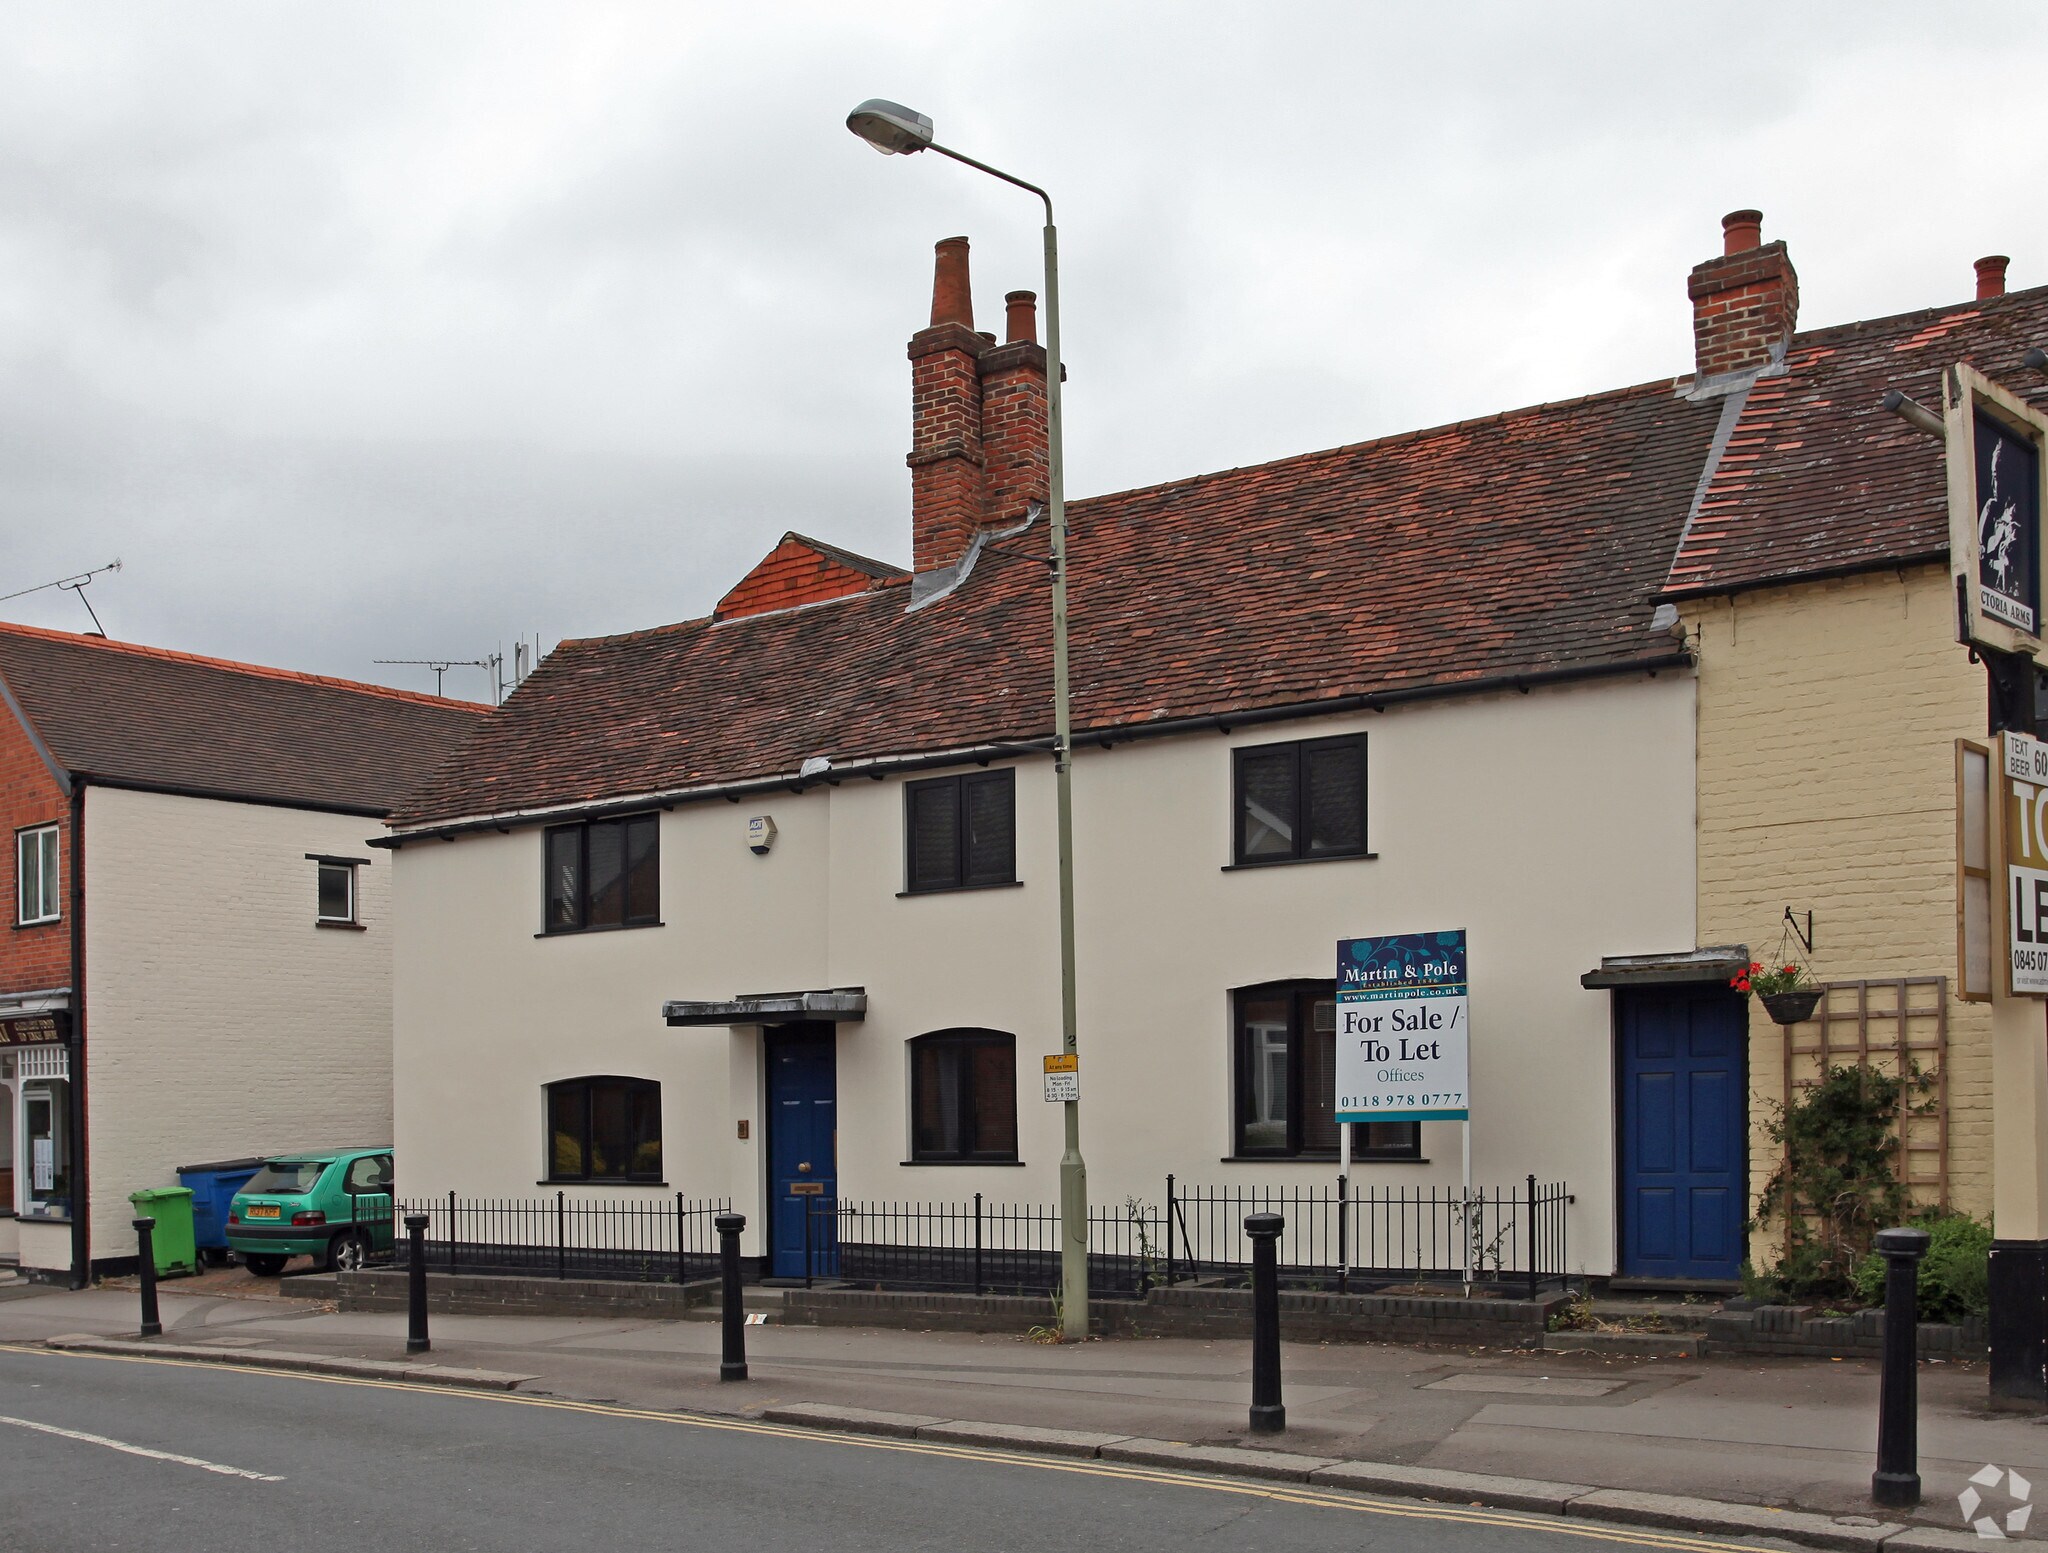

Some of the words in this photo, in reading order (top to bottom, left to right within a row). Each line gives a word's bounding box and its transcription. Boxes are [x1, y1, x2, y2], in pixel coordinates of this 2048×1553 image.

[1980, 590, 2008, 615] CTORIA
[2010, 605, 2031, 626] ARMS
[2010, 736, 2029, 758] TEXT
[2010, 756, 2031, 777] BEER
[2015, 876, 2048, 944] LE
[2014, 949, 2036, 971] 0845
[1344, 966, 1397, 983] Martin
[1404, 964, 1417, 978] &
[1423, 960, 1458, 977] Pole
[1343, 987, 1459, 1001] www.martinpole.co.uk
[1362, 979, 1413, 988] Established
[1344, 1011, 1383, 1034] For
[1392, 1006, 1443, 1031] Sale
[1450, 1005, 1460, 1029] /
[1360, 1039, 1390, 1062] To
[1399, 1038, 1441, 1061] Let
[1377, 1068, 1425, 1083] Offices
[1341, 1095, 1379, 1107] 0118
[1386, 1094, 1415, 1106] 978
[1421, 1093, 1462, 1106] 0777
